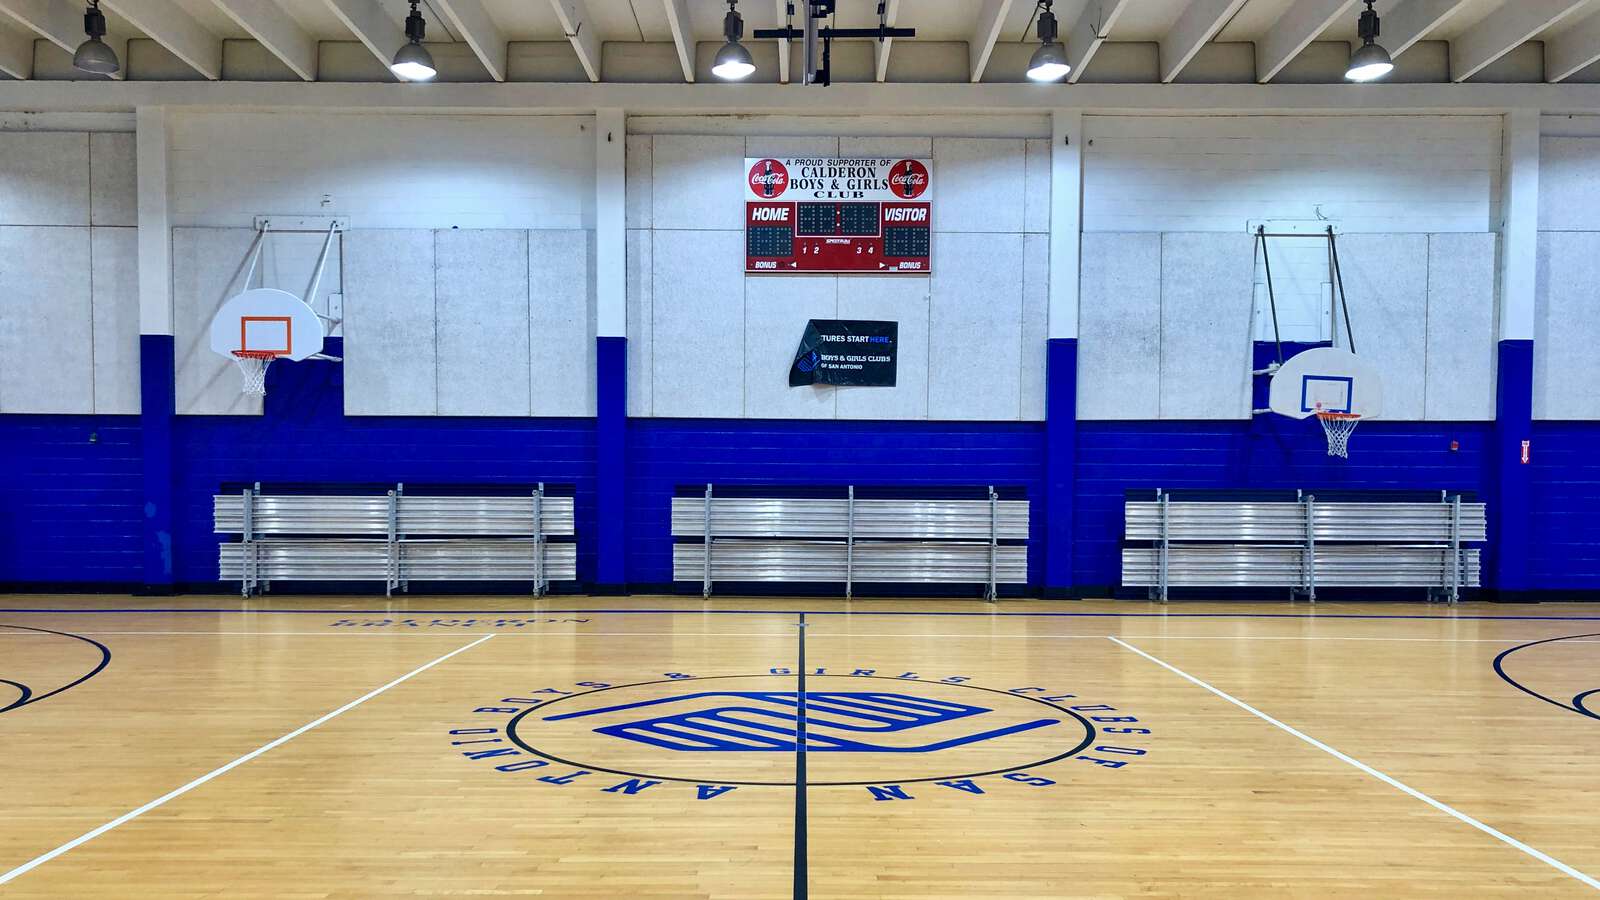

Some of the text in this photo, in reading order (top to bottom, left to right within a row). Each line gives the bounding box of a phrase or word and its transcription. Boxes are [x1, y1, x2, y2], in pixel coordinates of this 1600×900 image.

[794, 159, 823, 167] PROUD
[827, 159, 876, 167] SUPPORTER
[880, 159, 892, 167] OF
[801, 167, 876, 178] CALDERON
[790, 178, 889, 190] BOYS & GIRLS
[813, 191, 864, 199] CLUB
[752, 207, 790, 221] HOME
[884, 208, 927, 222] VISITOR
[802, 246, 820, 254] 1 2
[856, 246, 874, 254] 3 4
[755, 261, 777, 269] BONUS
[899, 261, 921, 269] BONUS
[821, 334, 846, 342] TURES
[846, 335, 870, 343] START
[840, 354, 846, 362] &
[770, 668, 971, 683] GIRLS
[472, 681, 611, 713] BOYS
[1008, 687, 1151, 735] CLUBS
[1076, 746, 1147, 769] OF
[449, 727, 738, 800] ANTONIO
[866, 772, 1057, 801] SAN
